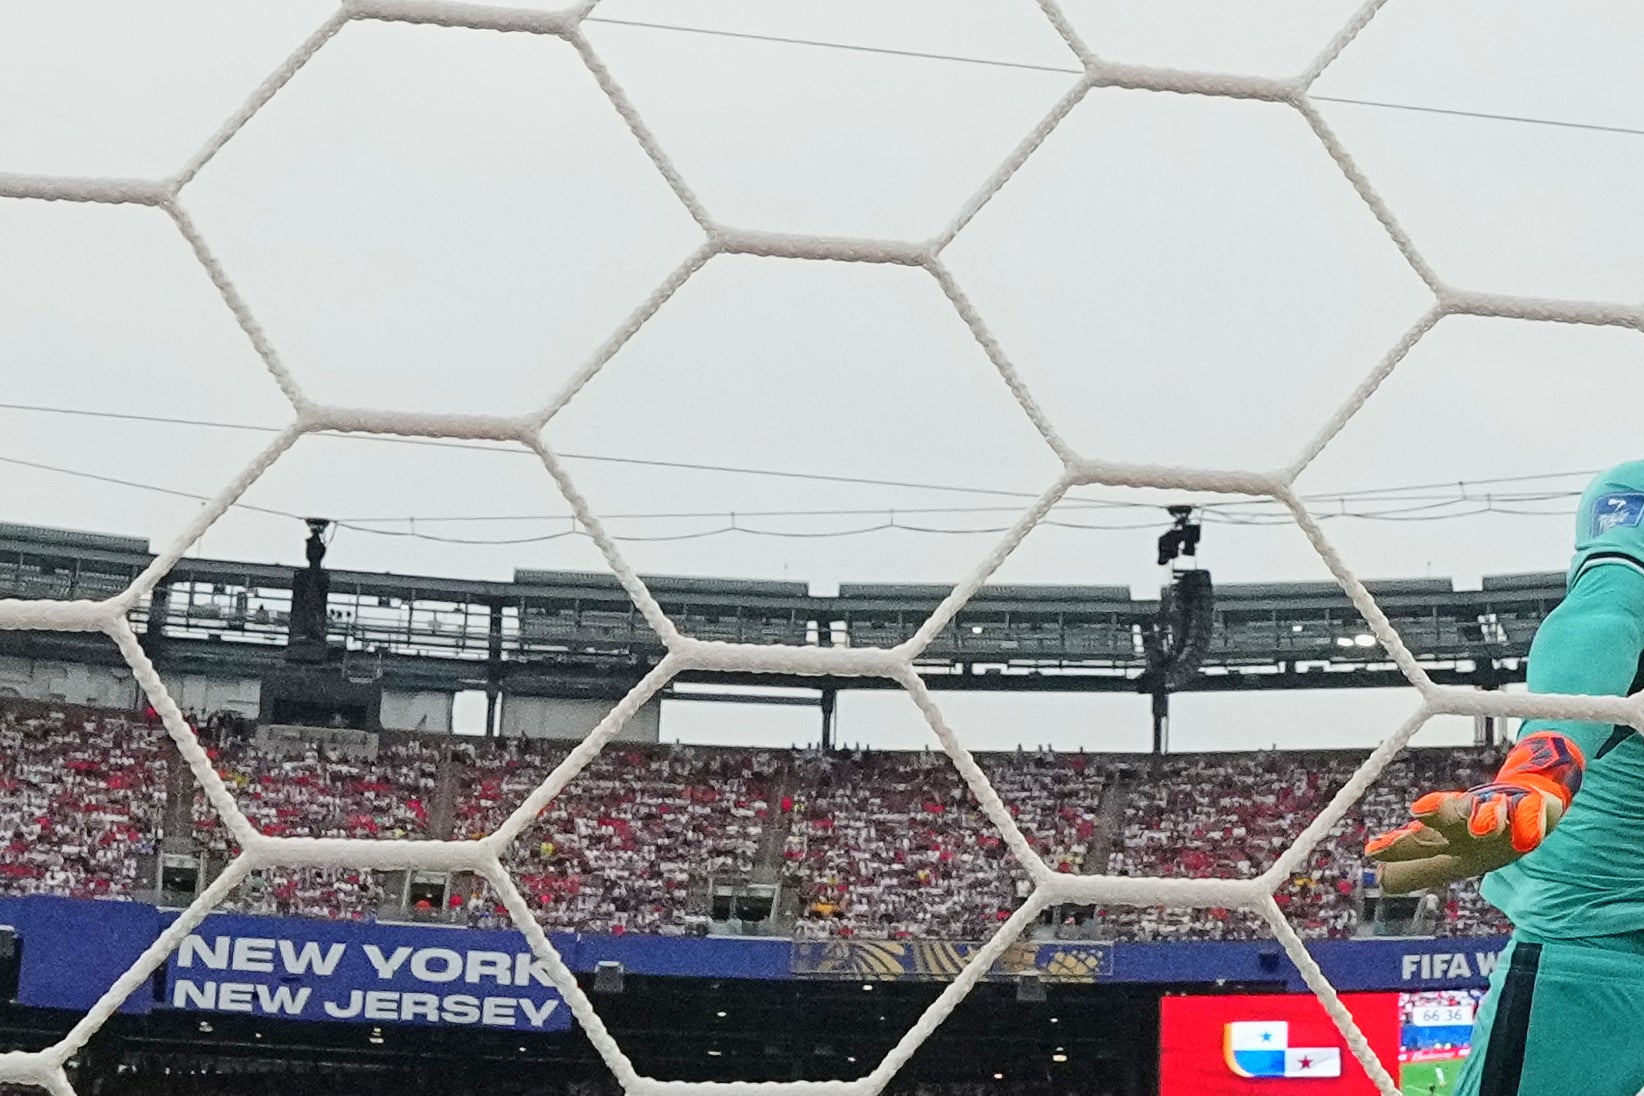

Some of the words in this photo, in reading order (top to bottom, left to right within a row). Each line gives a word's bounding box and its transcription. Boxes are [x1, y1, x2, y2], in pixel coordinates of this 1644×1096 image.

[176, 935, 346, 976] NEW
[362, 943, 560, 988] YORK
[1402, 953, 1472, 980] FIFA
[172, 981, 312, 1014] NEW
[325, 991, 560, 1028] JERSEY
